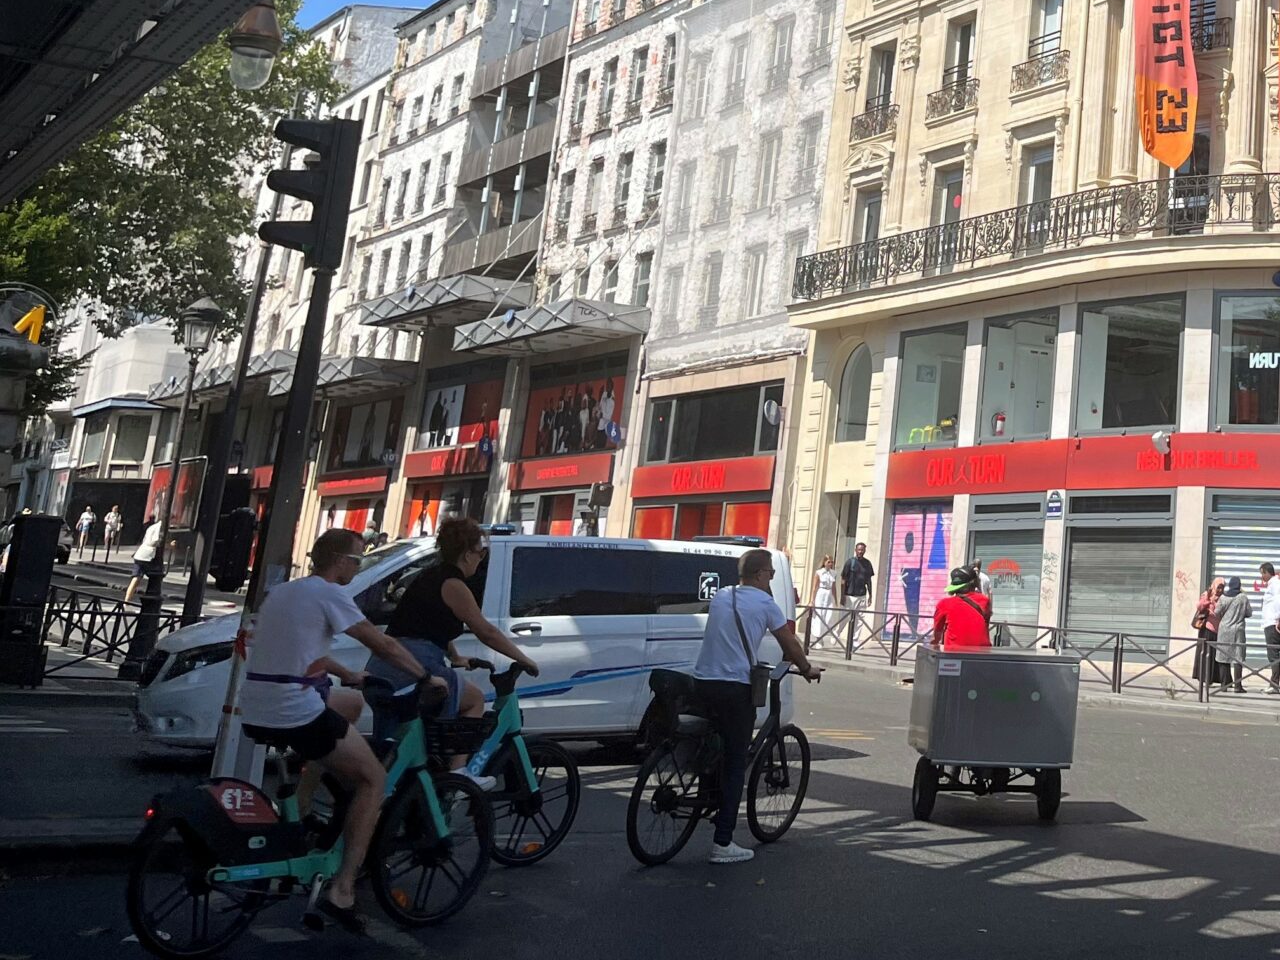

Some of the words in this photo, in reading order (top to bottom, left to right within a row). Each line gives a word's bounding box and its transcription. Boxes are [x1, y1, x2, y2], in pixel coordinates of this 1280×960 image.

[1156, 87, 1189, 134] 23
[927, 457, 955, 487] OUR
[968, 454, 1006, 484] TURN
[1163, 449, 1196, 470] OUR
